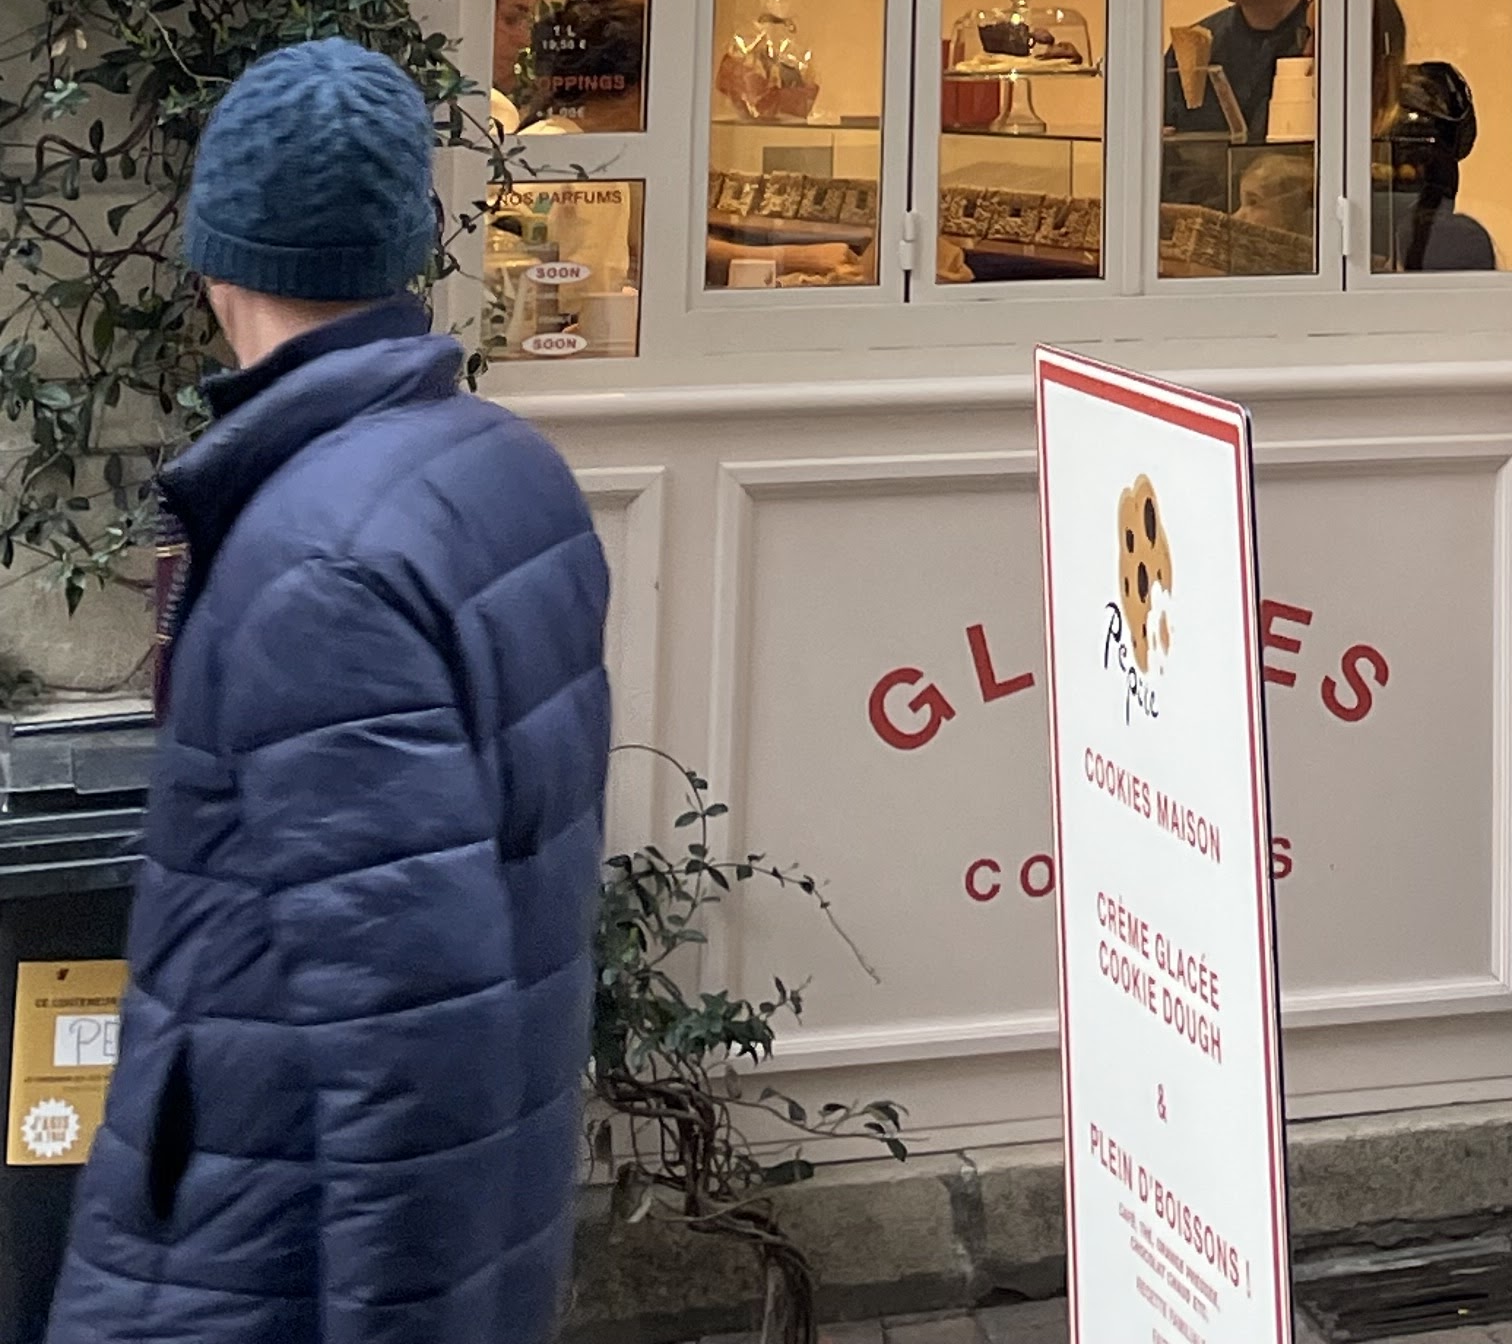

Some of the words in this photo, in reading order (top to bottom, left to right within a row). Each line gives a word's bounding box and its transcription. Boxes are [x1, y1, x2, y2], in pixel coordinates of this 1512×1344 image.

[532, 75, 625, 91] OPPINGS
[538, 190, 622, 205] PARFUMS
[535, 267, 580, 279] SOON
[532, 338, 577, 350] SOON
[867, 598, 1391, 751] GLES
[1084, 746, 1151, 819] COOKIES
[1156, 790, 1221, 864] MAISON
[1096, 890, 1150, 960] CRÈME
[1154, 932, 1220, 1012] GLACÉE
[1098, 939, 1158, 1014] COOKIE
[1162, 986, 1222, 1065] DOUGH
[1157, 1082, 1169, 1124] &
[1089, 1122, 1133, 1191] PLEIN
[1138, 1165, 1241, 1288] D'BOISSONS
